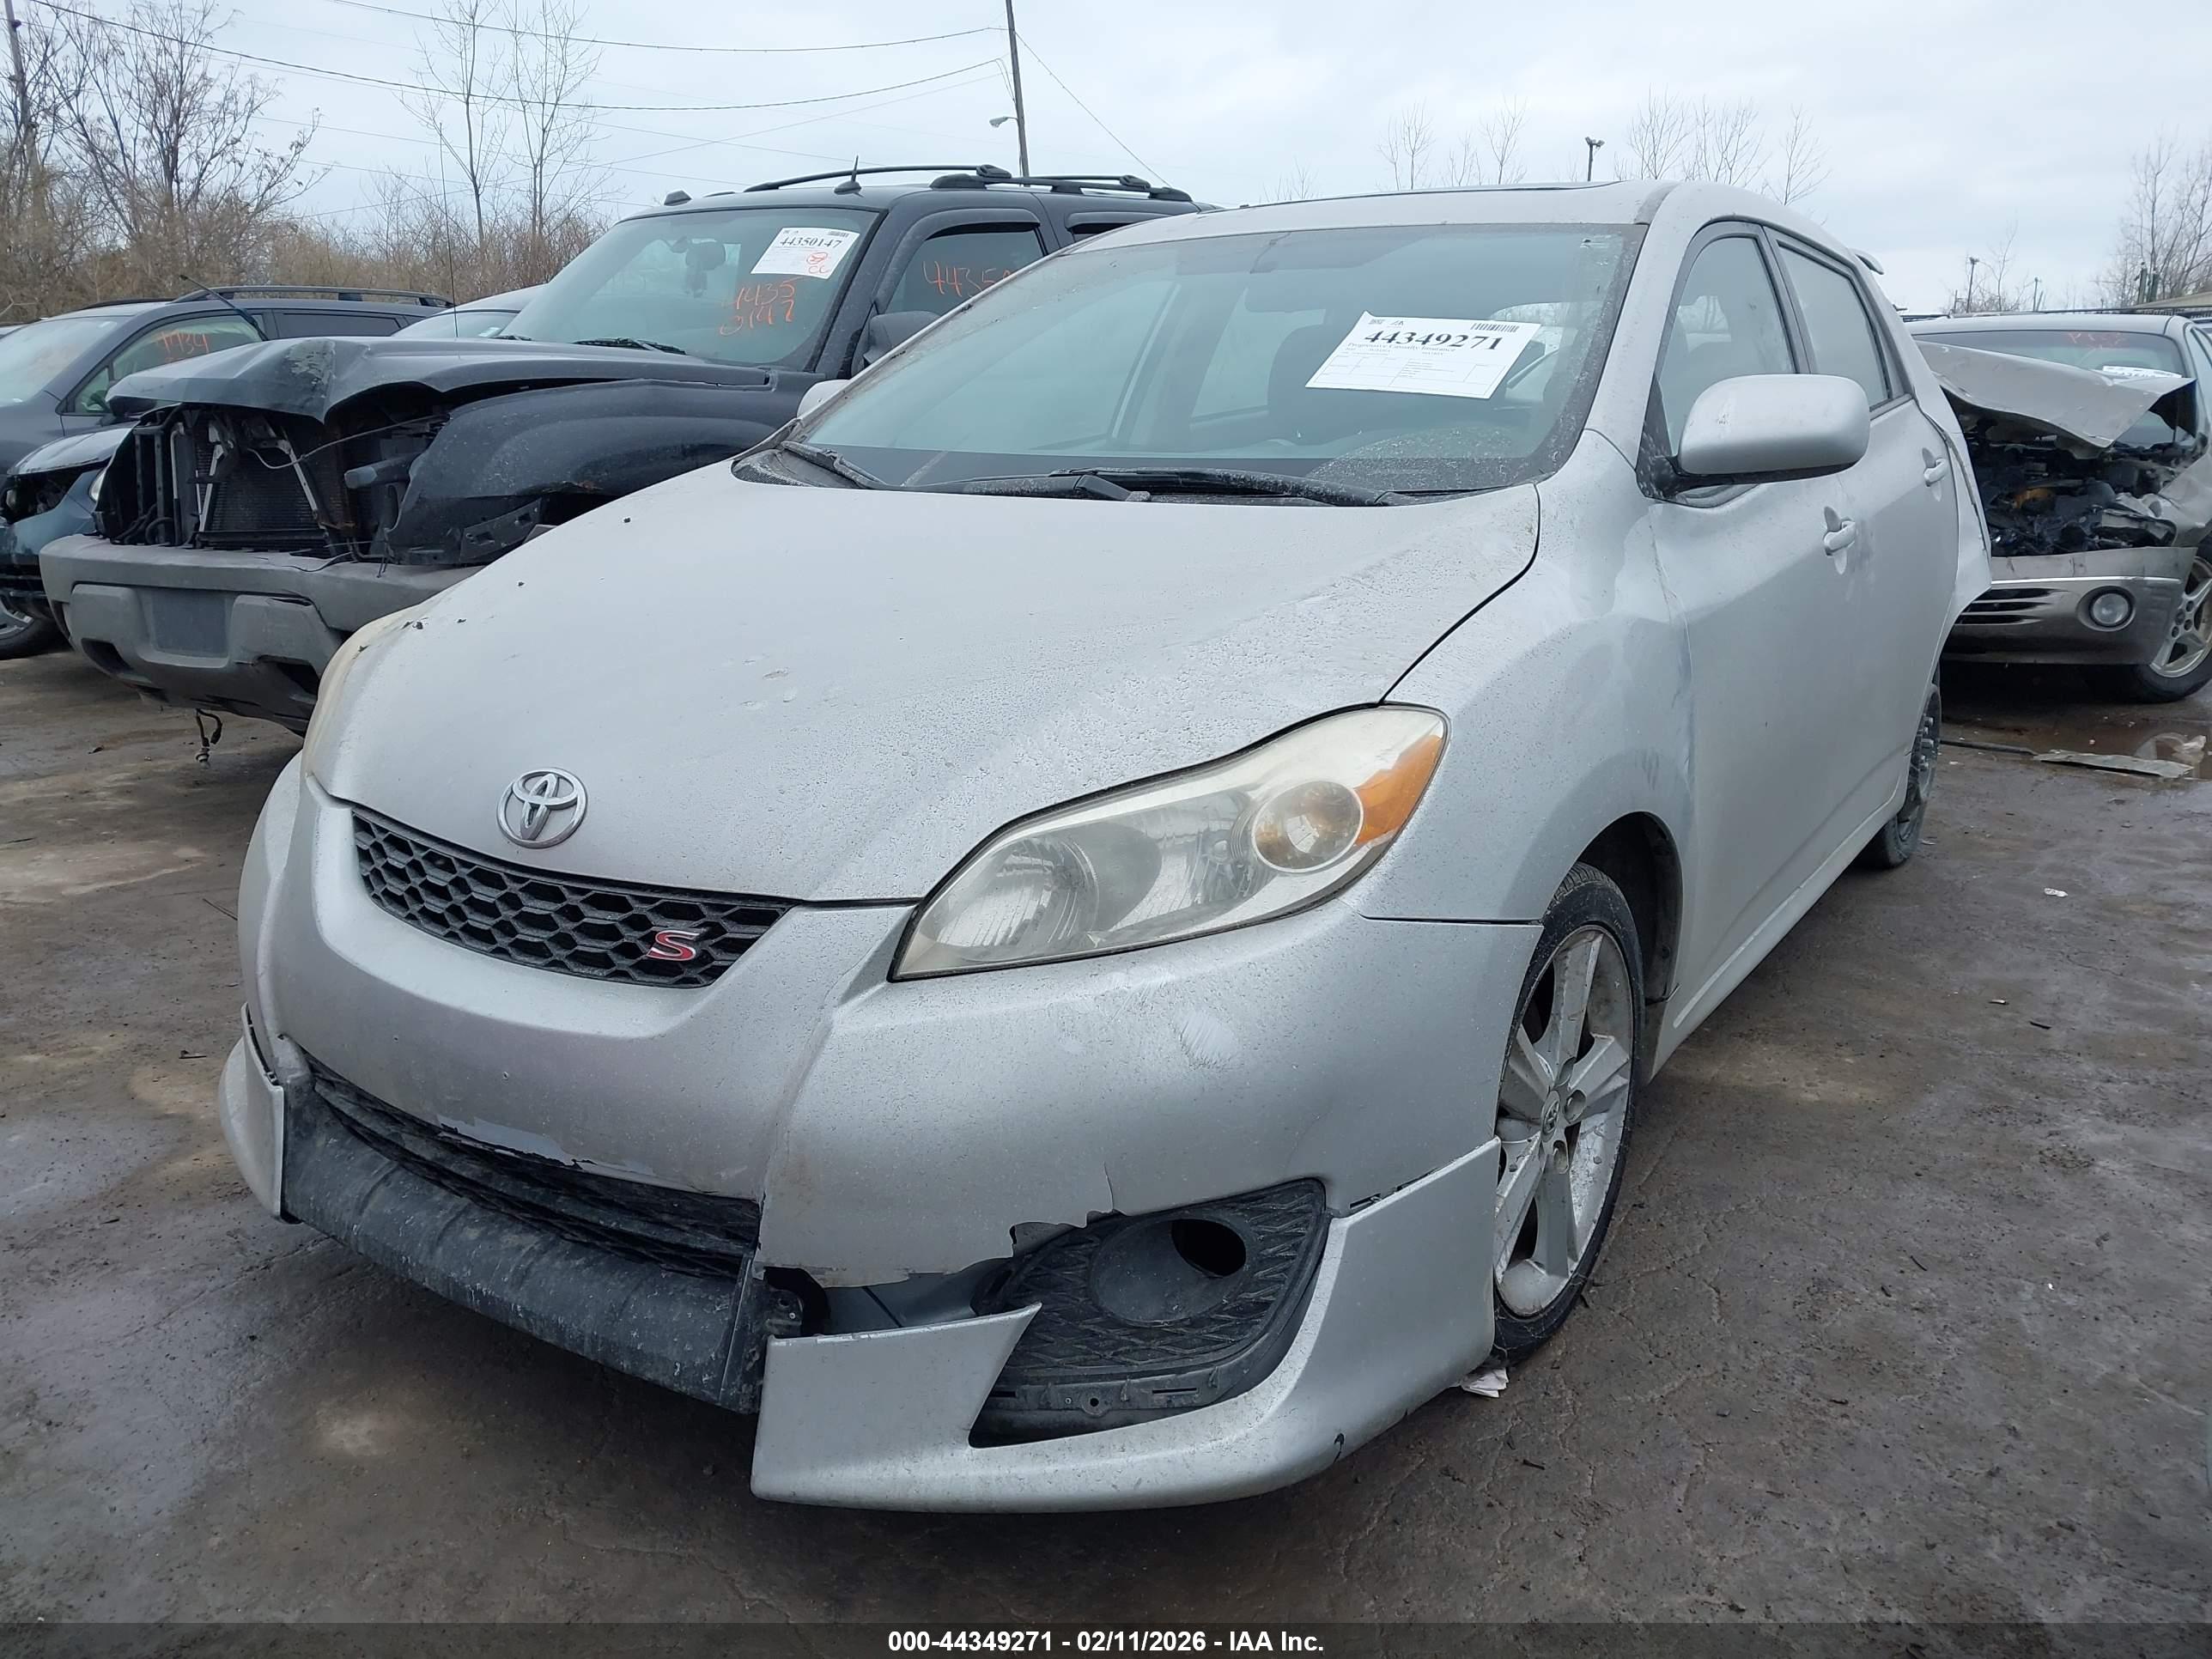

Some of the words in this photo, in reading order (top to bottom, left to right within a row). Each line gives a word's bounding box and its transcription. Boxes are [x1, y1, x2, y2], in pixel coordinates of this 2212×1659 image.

[780, 236, 842, 248] 44350147
[1364, 330, 1503, 350] 44349271
[647, 930, 700, 961] S
